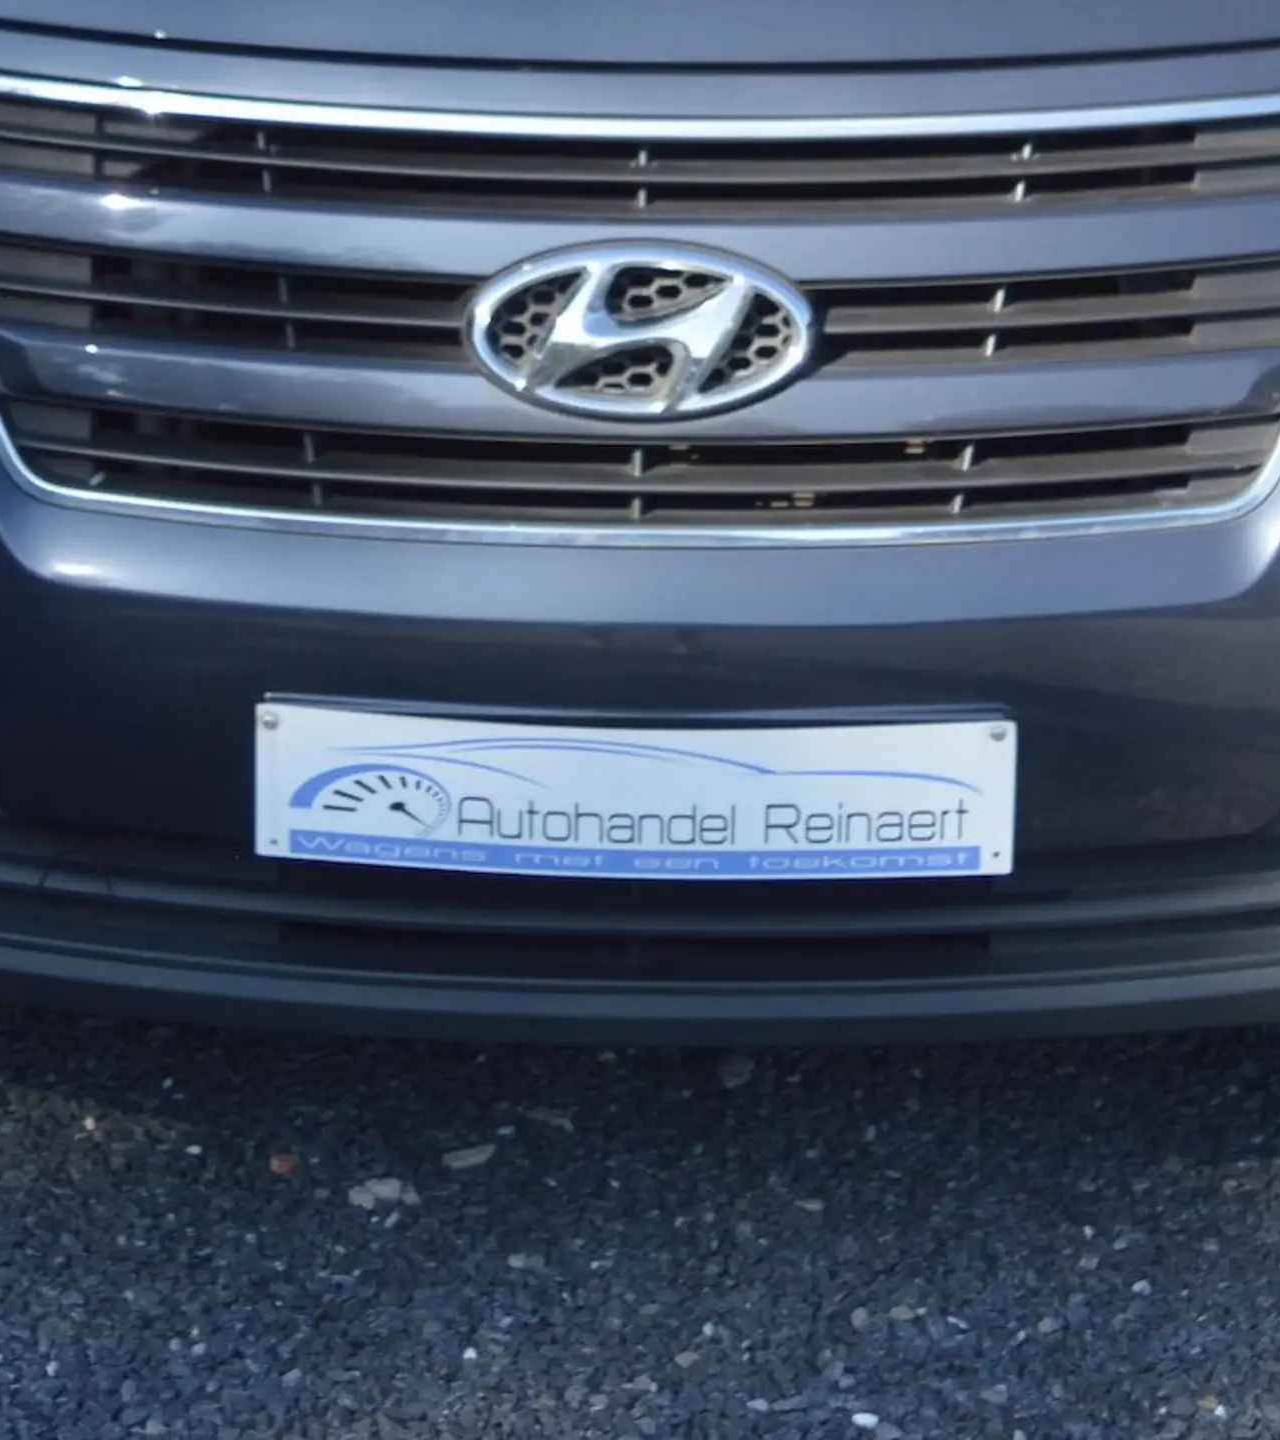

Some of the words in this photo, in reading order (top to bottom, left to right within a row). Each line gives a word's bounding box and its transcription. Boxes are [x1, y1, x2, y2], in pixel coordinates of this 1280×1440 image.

[457, 796, 737, 846] Autohandel
[762, 797, 970, 845] Reinaert
[297, 833, 488, 864] Wagens
[514, 850, 605, 869] met
[748, 849, 972, 872] toekomst
